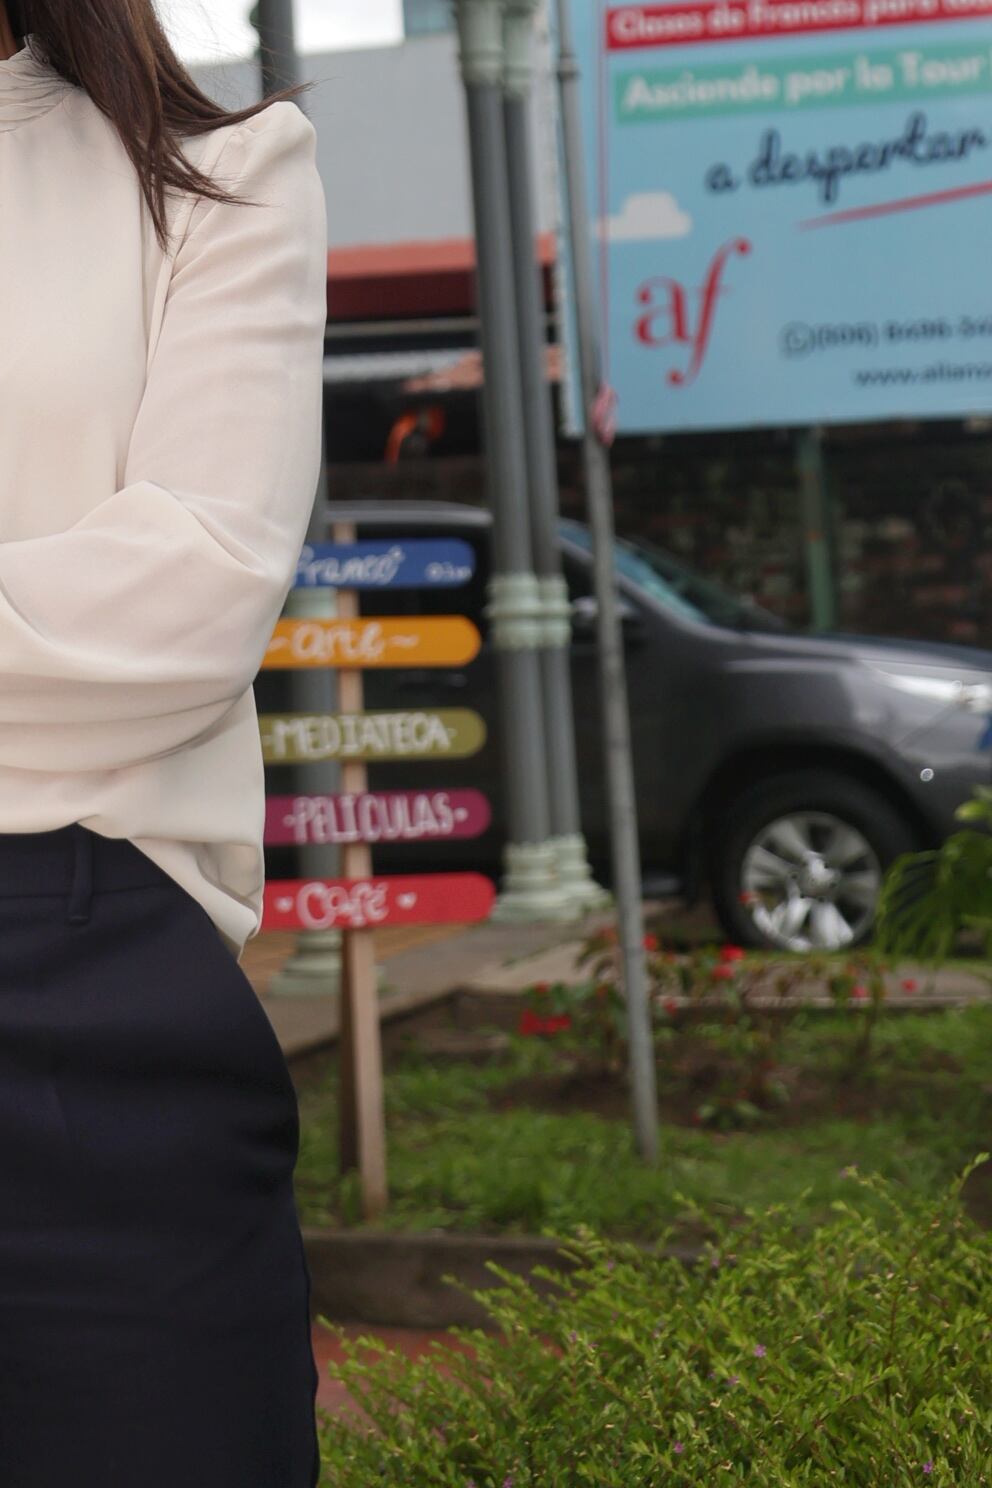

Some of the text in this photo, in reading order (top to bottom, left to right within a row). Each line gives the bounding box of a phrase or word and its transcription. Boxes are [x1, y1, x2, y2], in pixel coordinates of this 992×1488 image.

[709, 0, 745, 31] de
[622, 51, 984, 109] Asciende por la Tour
[706, 163, 739, 193] a
[273, 712, 451, 758] MEDIATECA
[296, 881, 389, 929] Café
